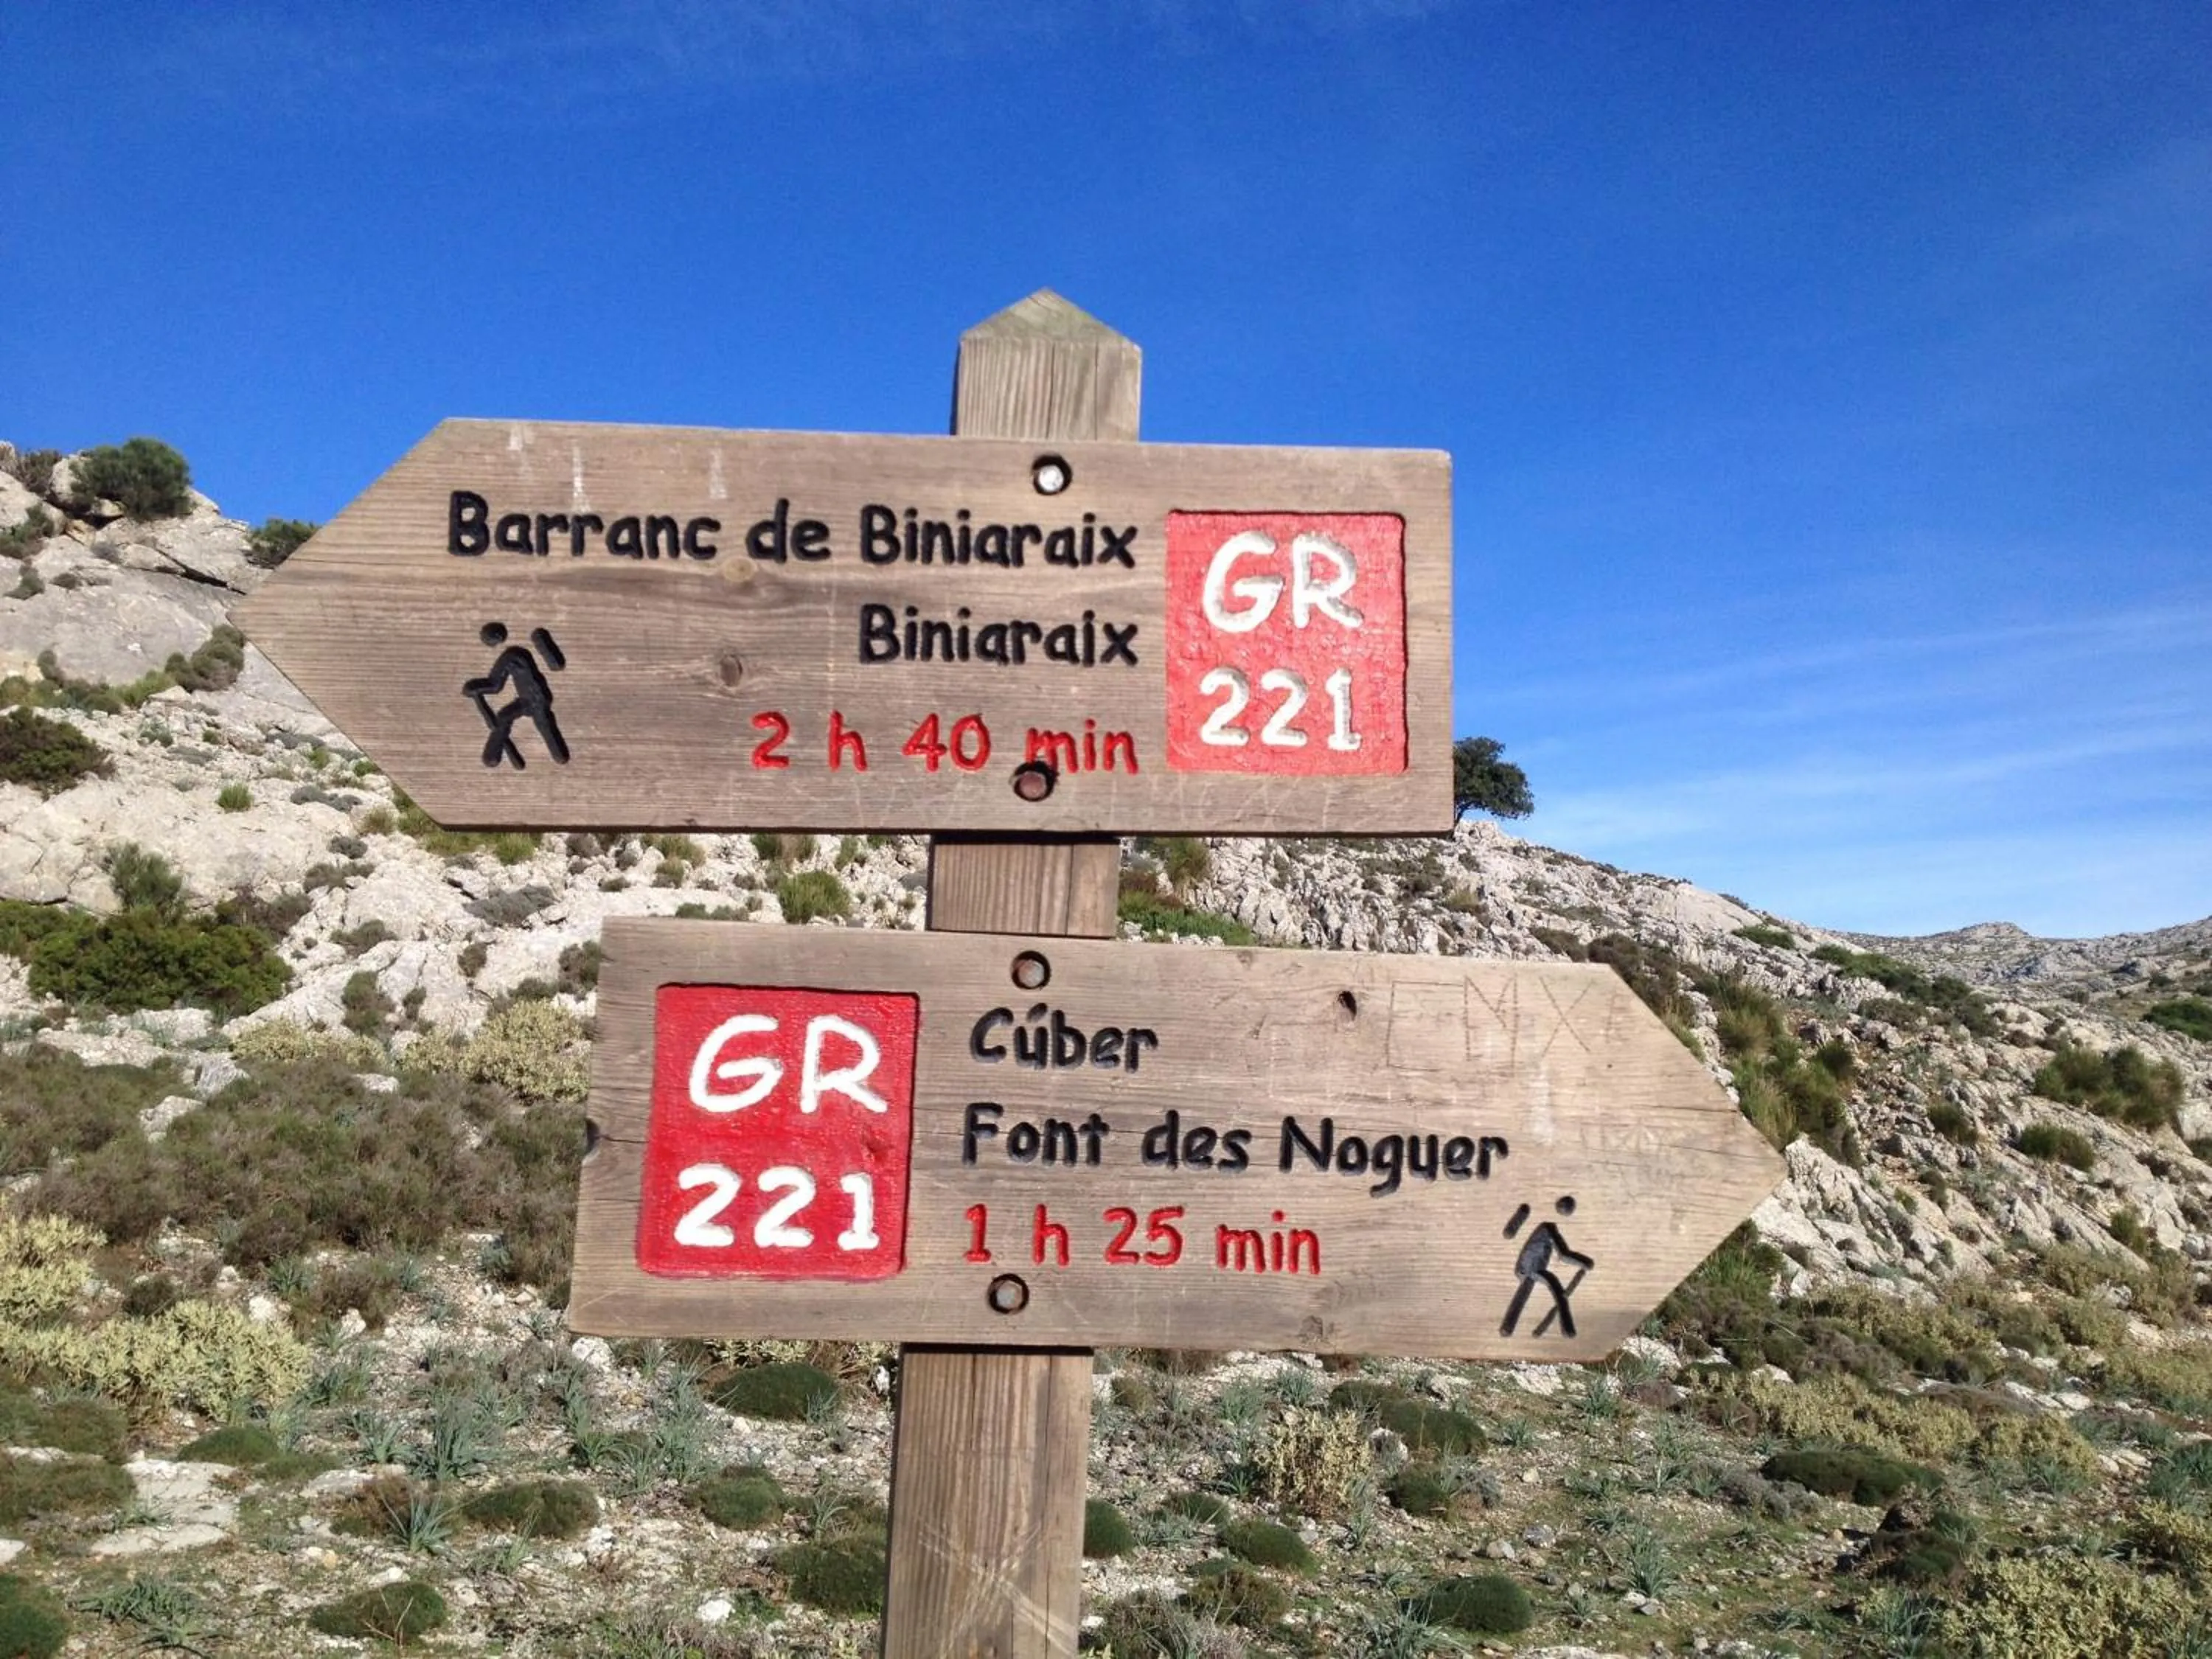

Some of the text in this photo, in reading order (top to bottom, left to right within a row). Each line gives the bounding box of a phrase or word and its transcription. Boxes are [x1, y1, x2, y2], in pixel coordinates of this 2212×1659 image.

[448, 490, 1138, 568] Barranc de Biniaraix
[1203, 530, 1364, 633] GR
[860, 603, 1138, 667] Biniaraix
[751, 711, 1139, 776] 2 h 40 min
[1200, 666, 1362, 751] 221
[689, 1014, 888, 1113] GR
[970, 1002, 1158, 1072] Cúber
[961, 1102, 1110, 1166] Font
[1141, 1110, 1252, 1170] des
[1279, 1116, 1509, 1197] Noguer
[674, 1163, 879, 1251] 221
[964, 1203, 1321, 1276] 1 h 25 min
